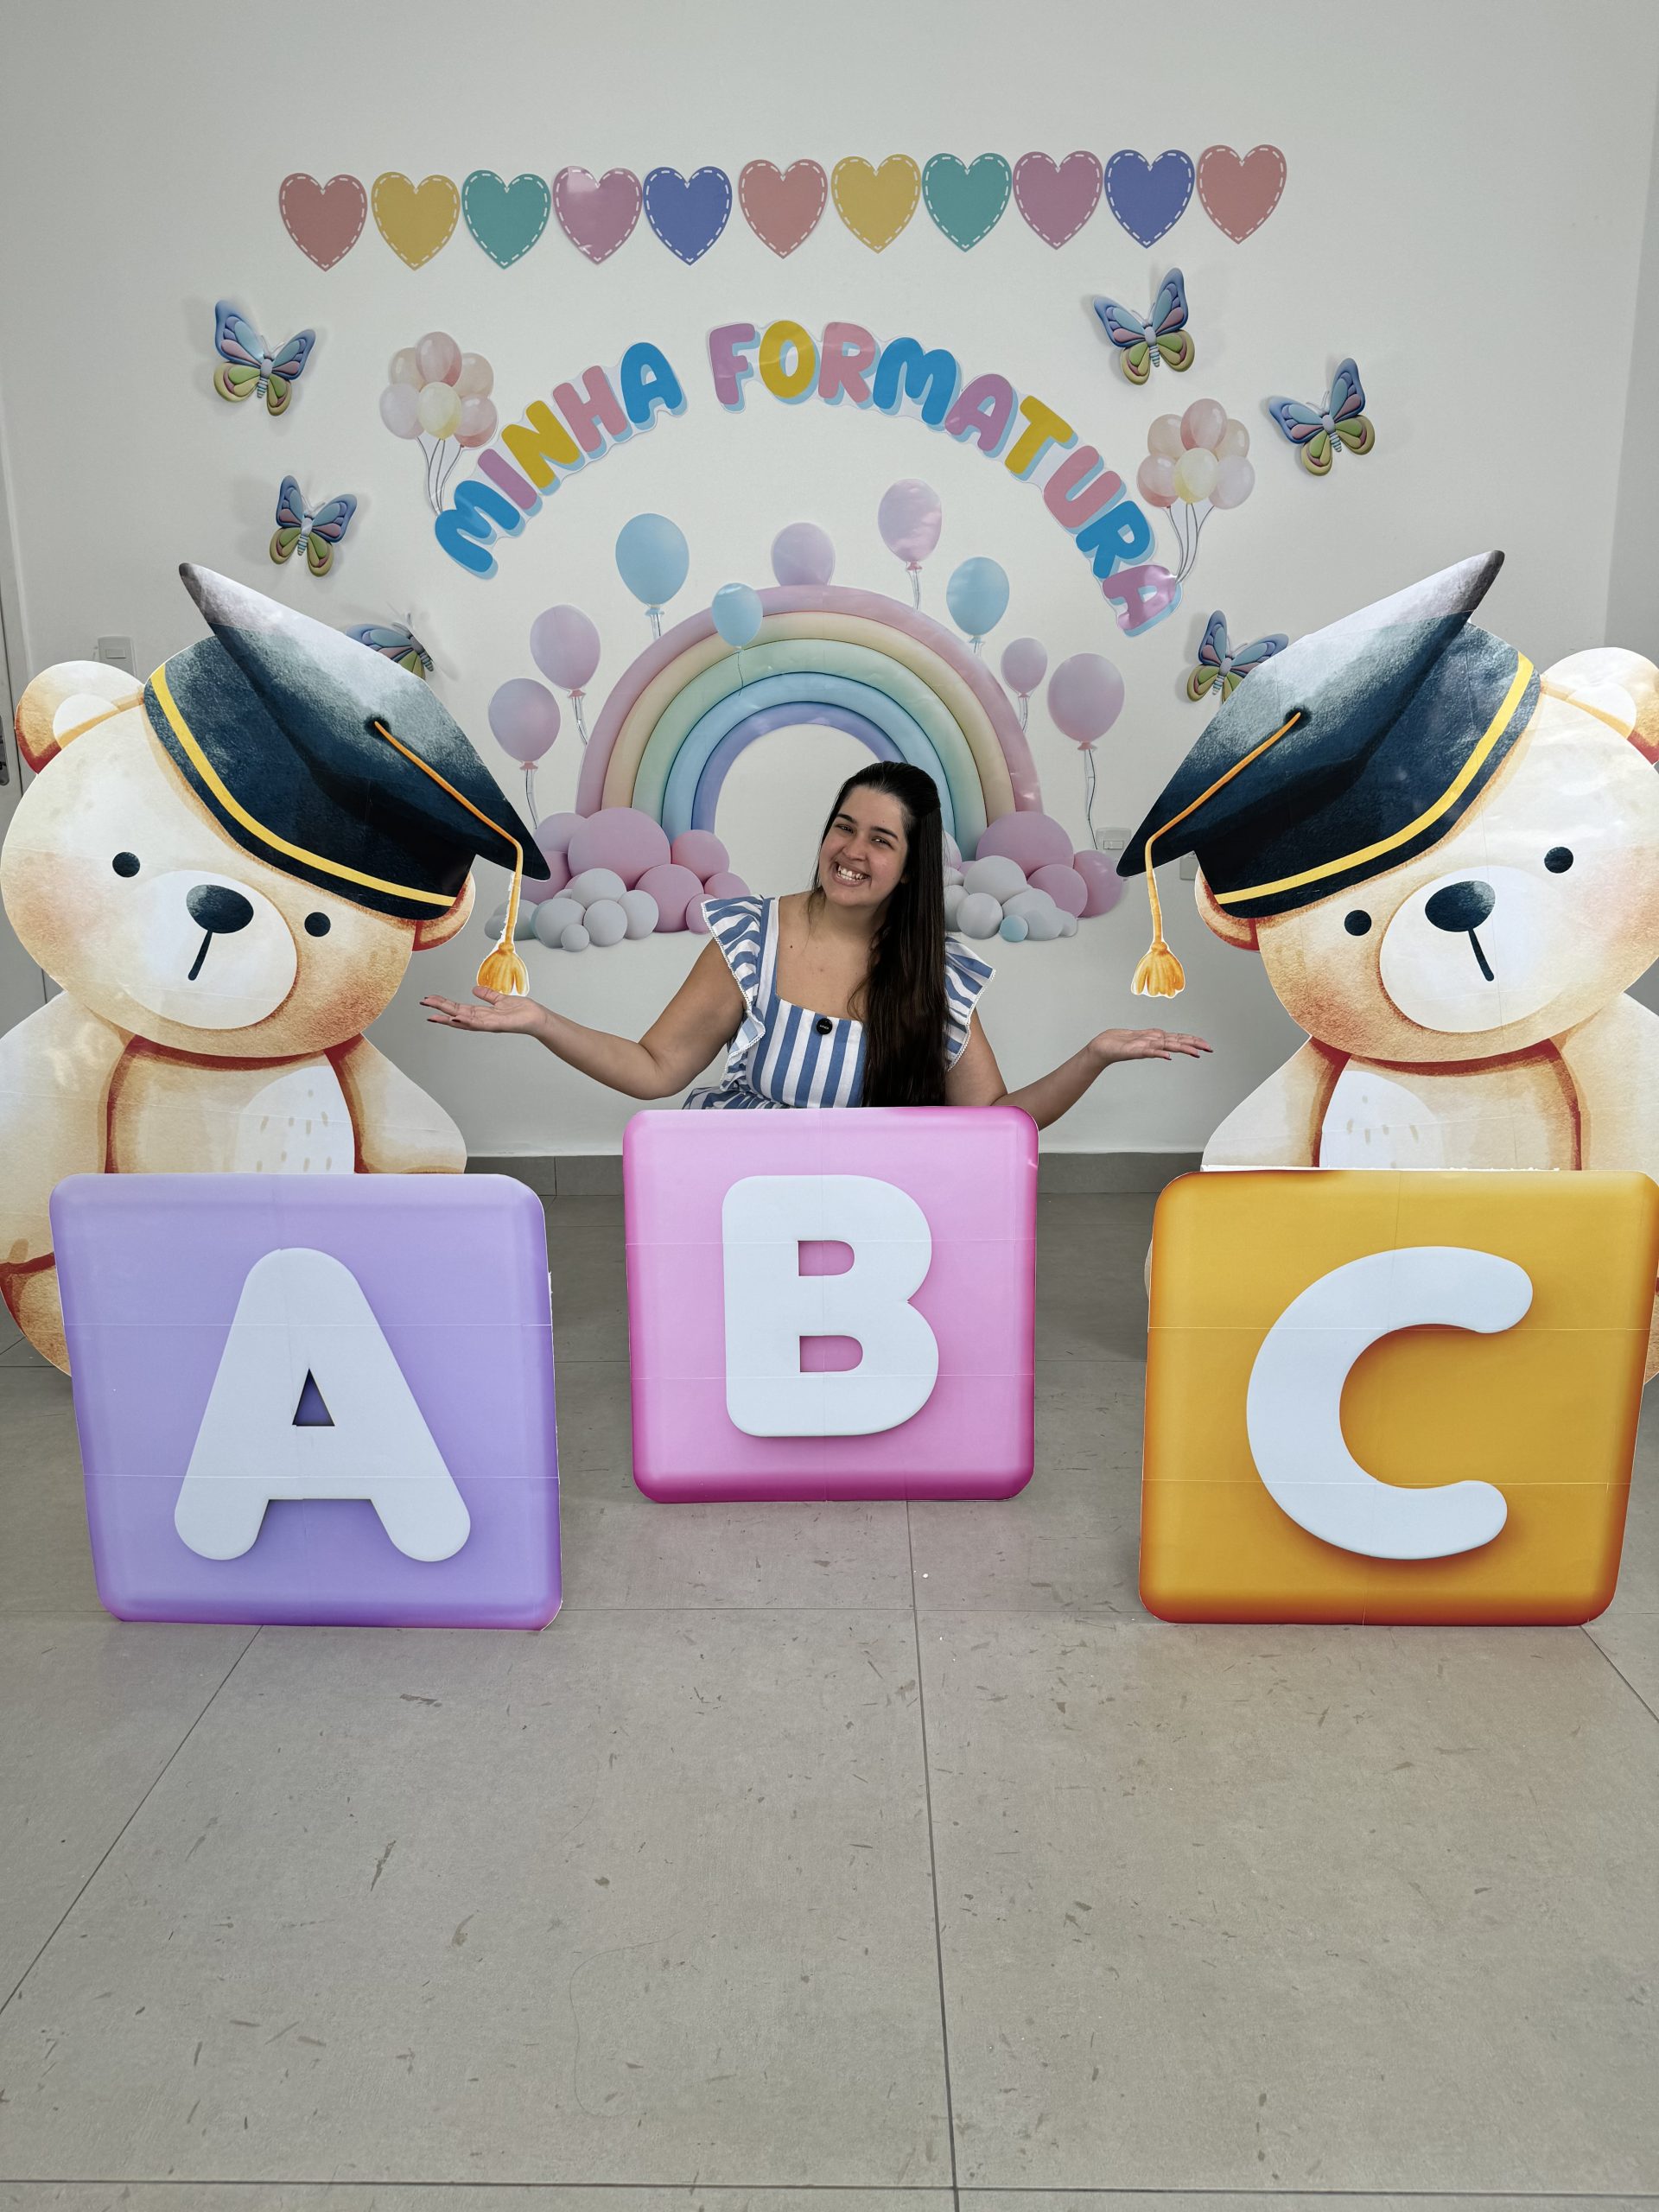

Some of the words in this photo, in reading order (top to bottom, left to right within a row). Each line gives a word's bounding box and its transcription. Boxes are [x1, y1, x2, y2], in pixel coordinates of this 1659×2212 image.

[435, 342, 688, 579] MINHA
[709, 321, 1182, 637] FORMATURA
[175, 1248, 471, 1562] A
[721, 1174, 939, 1437] B
[1246, 1246, 1534, 1560] C
